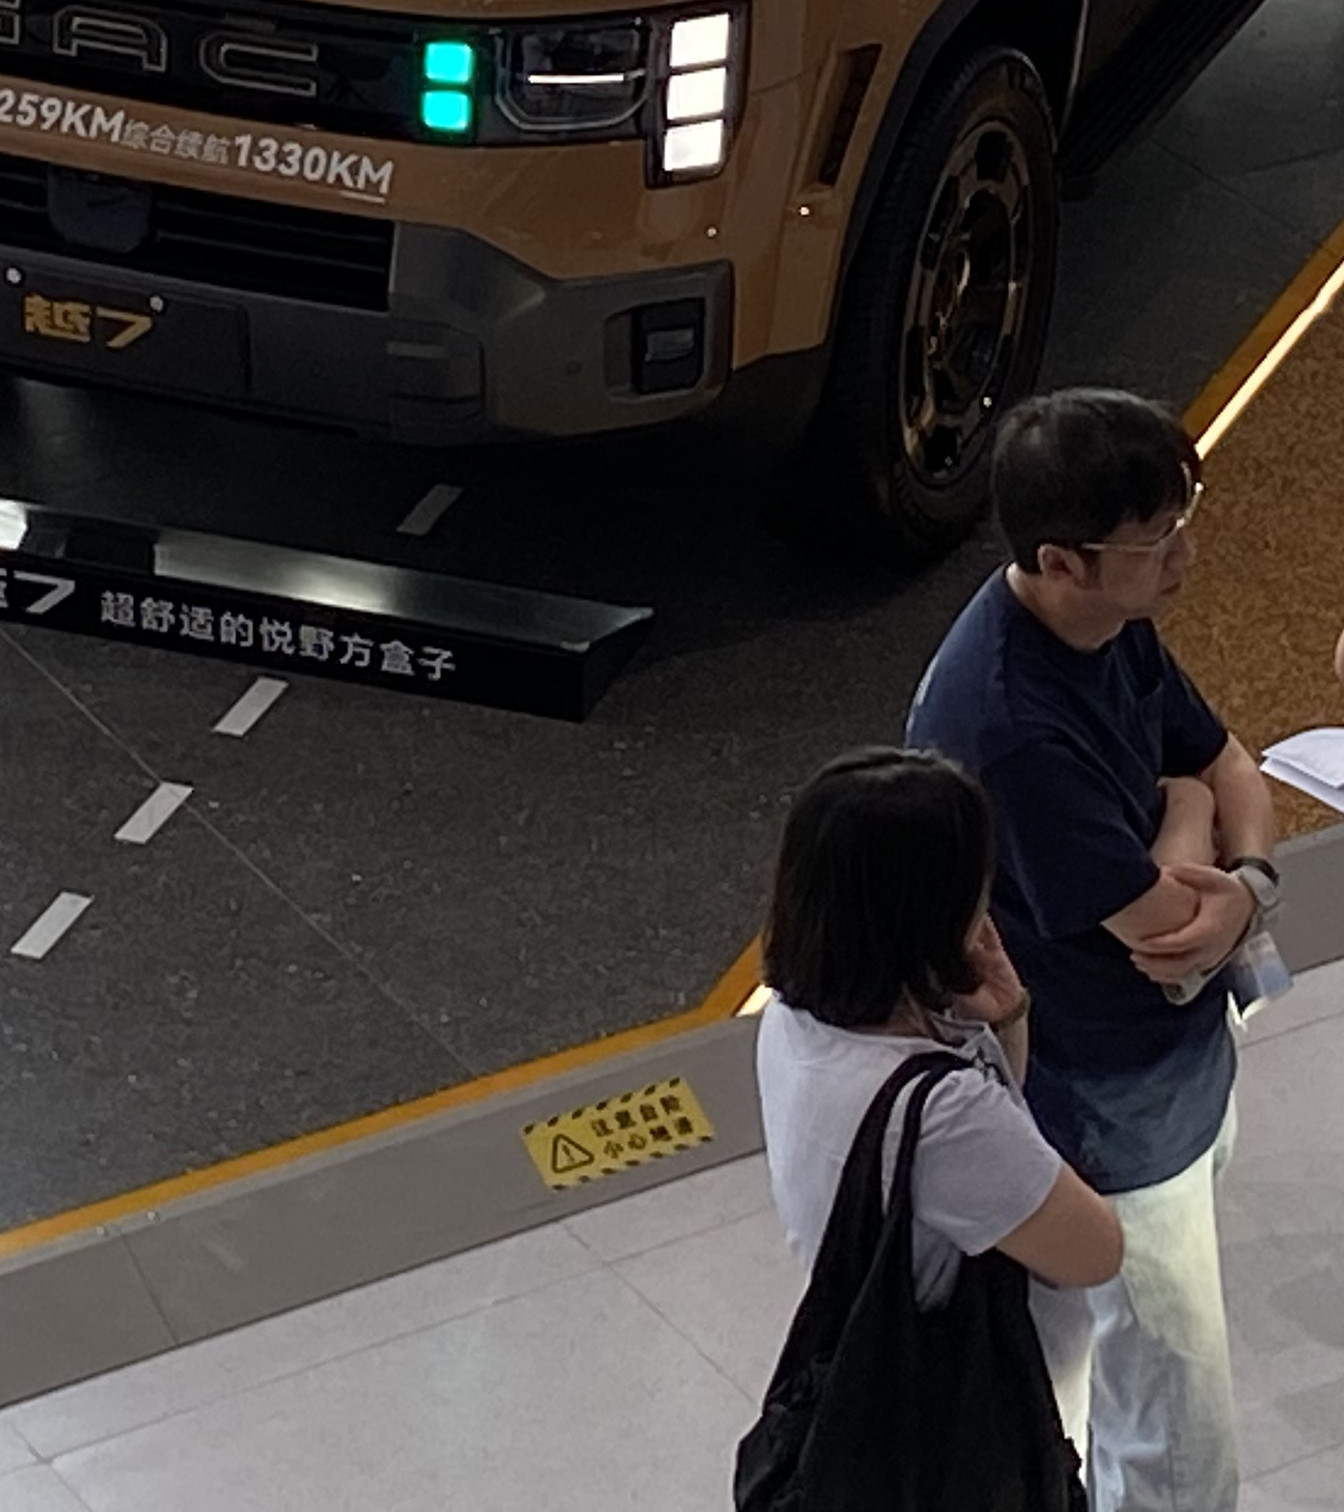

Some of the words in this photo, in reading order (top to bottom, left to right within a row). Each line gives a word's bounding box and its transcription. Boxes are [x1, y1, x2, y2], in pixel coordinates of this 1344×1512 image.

[24, 293, 154, 350] 越7
[99, 590, 456, 681] 超舒适的悦野方盒子
